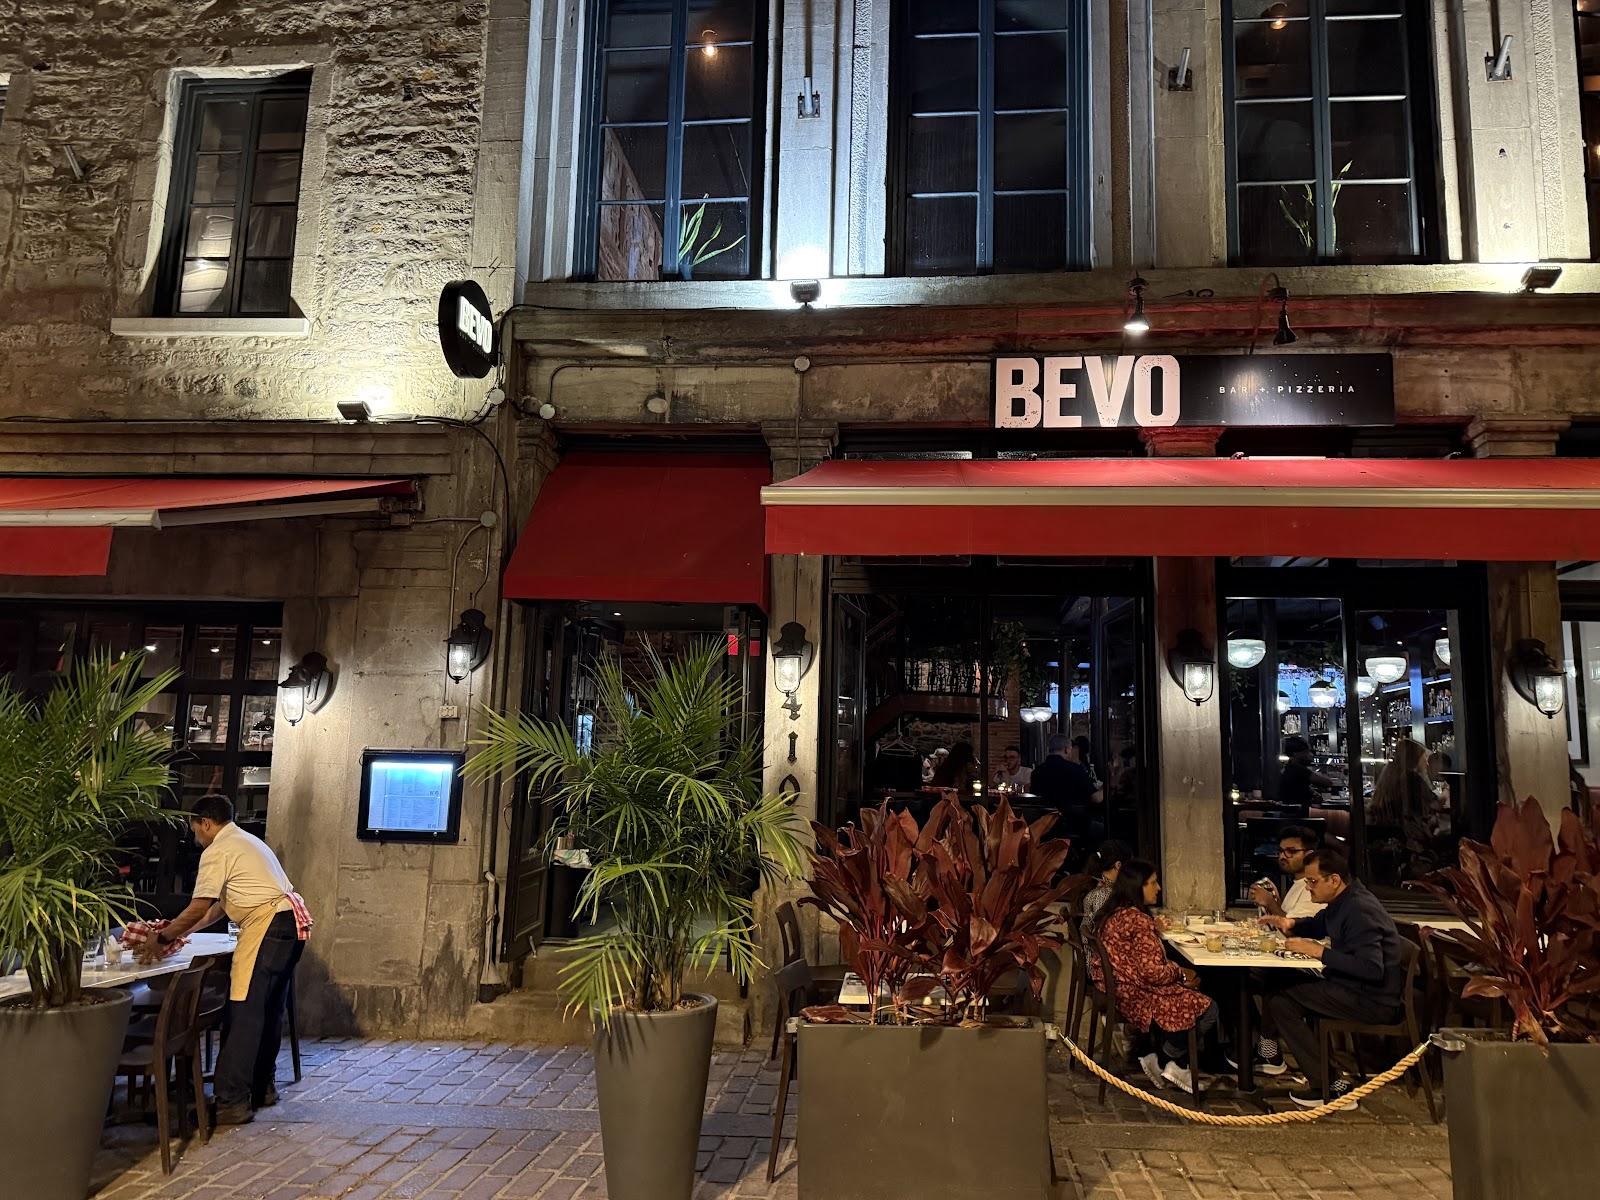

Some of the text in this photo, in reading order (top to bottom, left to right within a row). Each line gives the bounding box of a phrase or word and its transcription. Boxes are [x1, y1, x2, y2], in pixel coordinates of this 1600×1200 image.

[458, 296, 493, 354] BEVO
[995, 354, 1181, 428] BEVO
[1219, 386, 1249, 394] BAR
[1277, 385, 1355, 394] PIZZERIA
